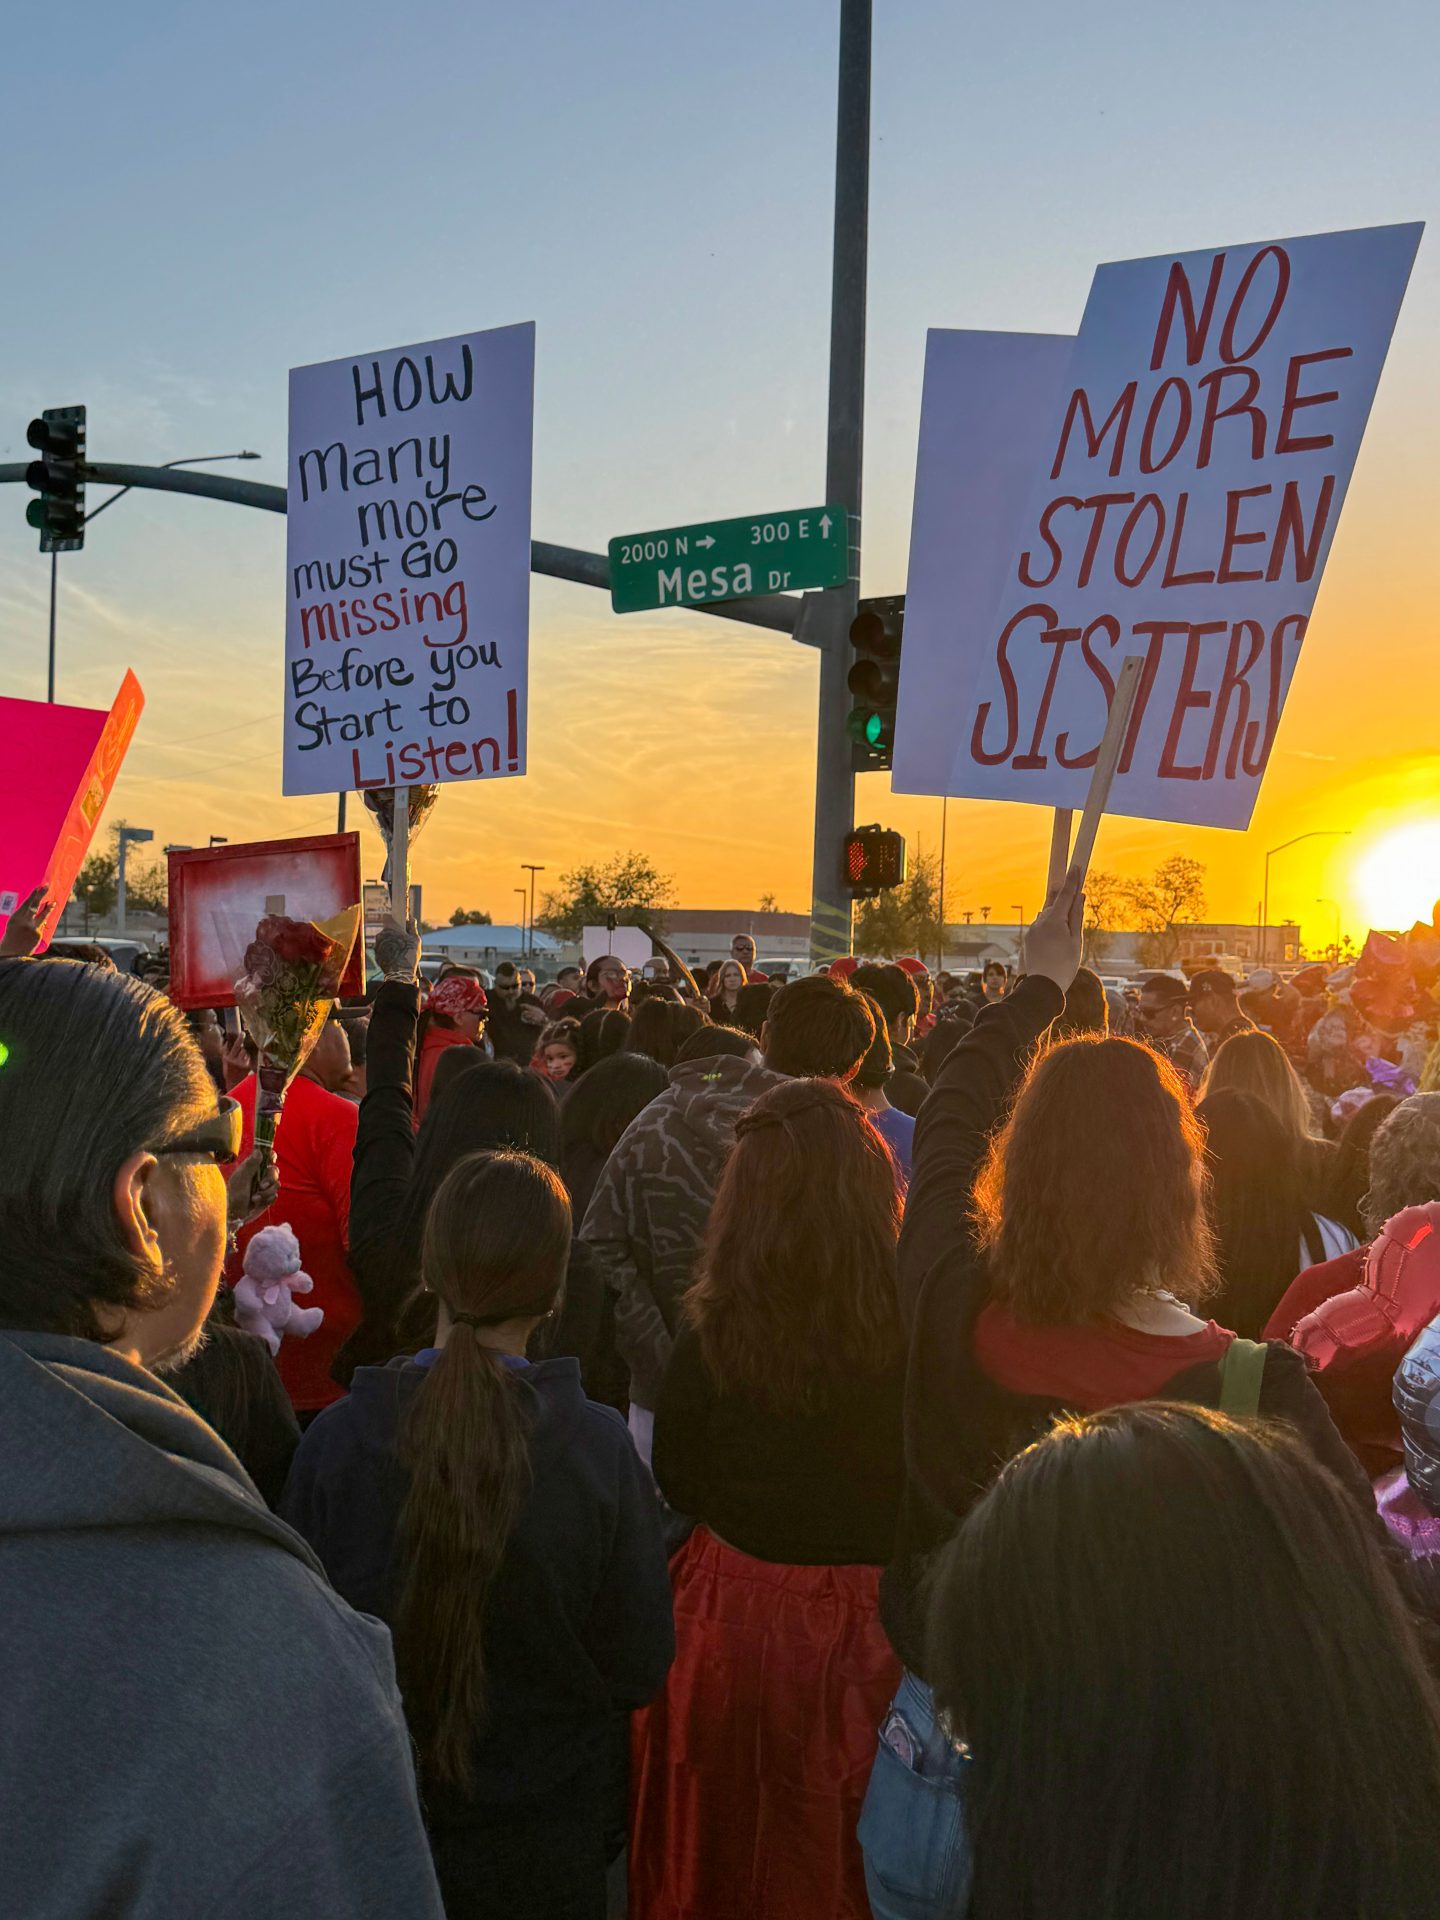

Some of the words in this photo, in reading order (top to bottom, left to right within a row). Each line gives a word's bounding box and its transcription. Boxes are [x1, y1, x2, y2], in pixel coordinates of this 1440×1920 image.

[1150, 244, 1291, 371] NO
[352, 345, 473, 426] HOW
[1050, 346, 1354, 480] MORE
[357, 485, 498, 548] more
[751, 522, 790, 545] 300
[799, 519, 809, 538] E
[1018, 475, 1336, 589] STOLEN
[294, 551, 390, 599] must
[401, 538, 458, 579] GO
[621, 540, 668, 564] 2000
[676, 536, 688, 556] N
[657, 562, 753, 604] Mesa
[768, 570, 791, 590] Dr
[300, 580, 468, 649] missing
[291, 647, 414, 699] Before
[430, 641, 503, 692] you
[971, 602, 1309, 781] SISTERS
[352, 687, 519, 789] Listen!
[419, 691, 471, 727] to
